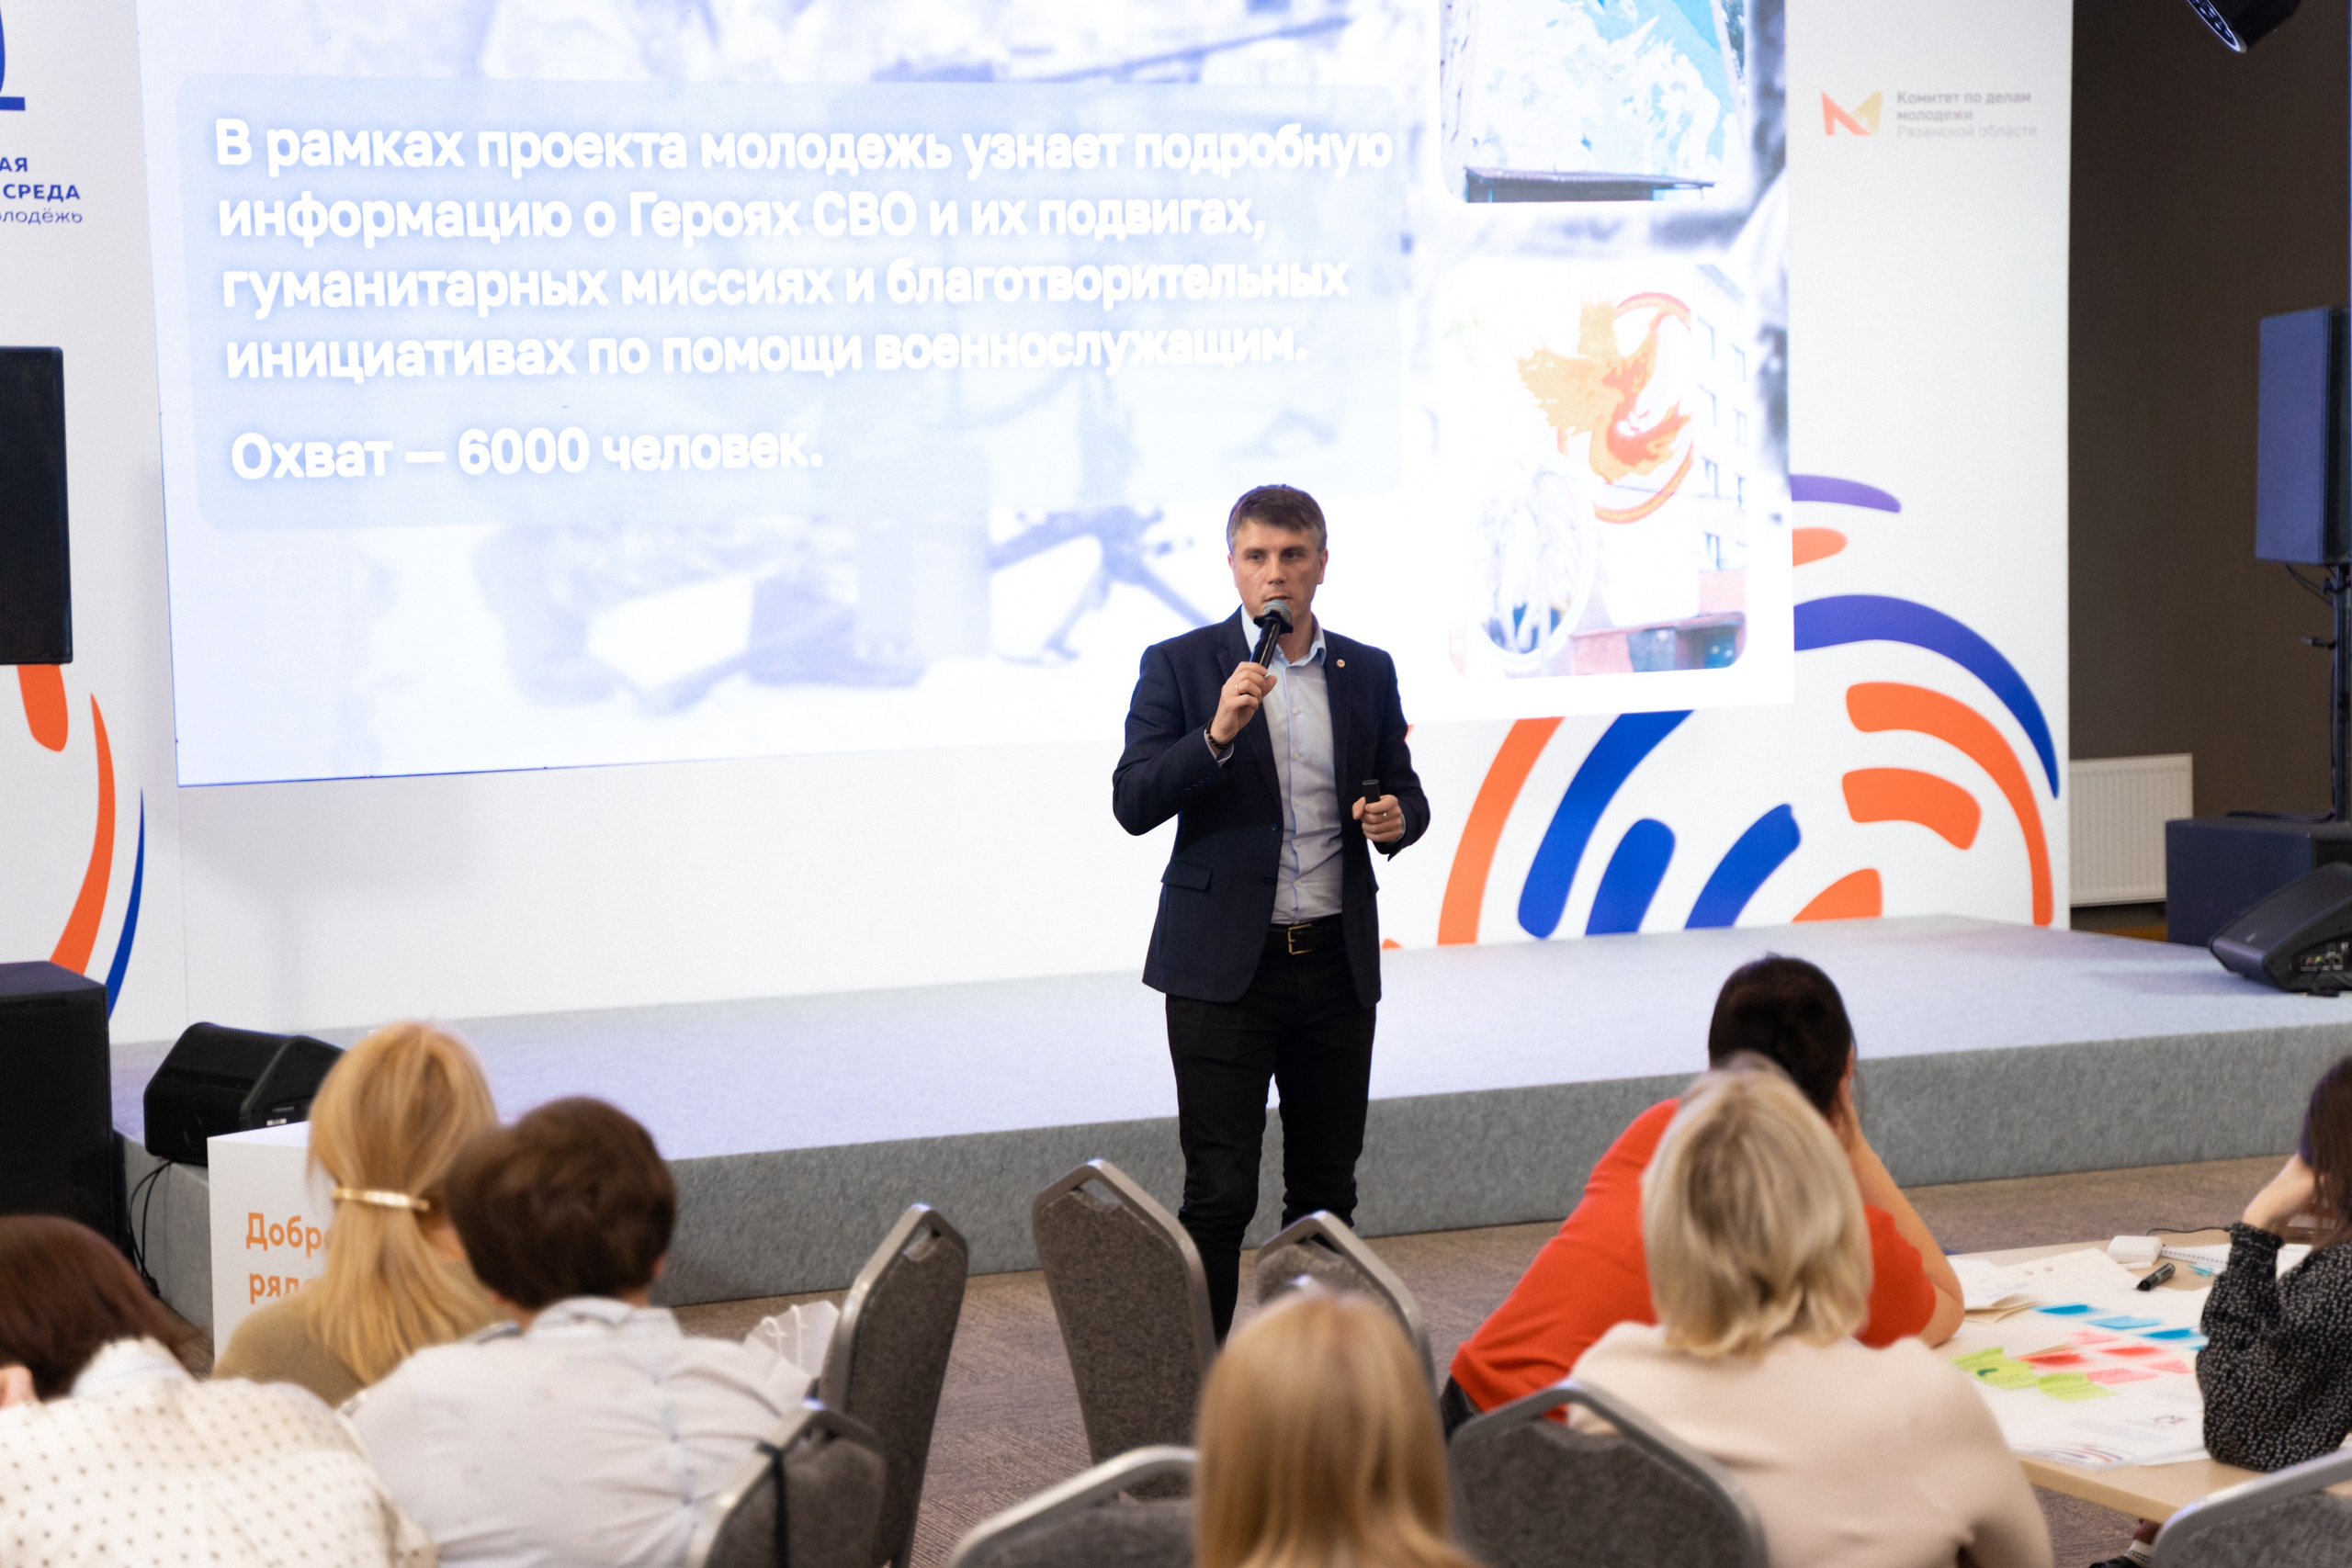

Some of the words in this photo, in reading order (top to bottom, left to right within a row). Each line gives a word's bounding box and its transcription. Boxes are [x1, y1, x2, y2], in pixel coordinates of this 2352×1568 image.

[1896, 91, 1960, 105] Комитет
[1964, 94, 1982, 105] по
[1985, 92, 2031, 107] делам
[1896, 109, 1973, 122] молодежи
[1896, 124, 1974, 138] Рязанской
[1978, 123, 2038, 137] области
[215, 118, 252, 166] В
[267, 127, 464, 177] рамках
[479, 129, 687, 177] проекта
[699, 130, 952, 175] молодежь
[963, 131, 1124, 179] узнает
[1136, 124, 1394, 178] подробную
[3, 184, 81, 202] СРЕДА
[0, 208, 84, 225] лодёжь
[219, 191, 571, 249] информацию
[583, 202, 616, 238] о
[629, 192, 801, 247] Героях
[813, 190, 916, 237] СВО
[930, 199, 957, 235] и
[971, 199, 1025, 235] их
[1039, 195, 1265, 241] подвигах,
[222, 266, 608, 320] гуманитарных
[621, 265, 833, 305] миссиях
[845, 265, 875, 302] и
[887, 257, 1349, 310] благотворительных
[227, 335, 576, 384] инициативах
[588, 335, 650, 374] по
[662, 333, 863, 377] помощи
[876, 327, 1308, 376] военнослужащим.
[232, 432, 392, 479] Охват
[458, 427, 591, 476] 6000
[603, 429, 824, 471] человек.
